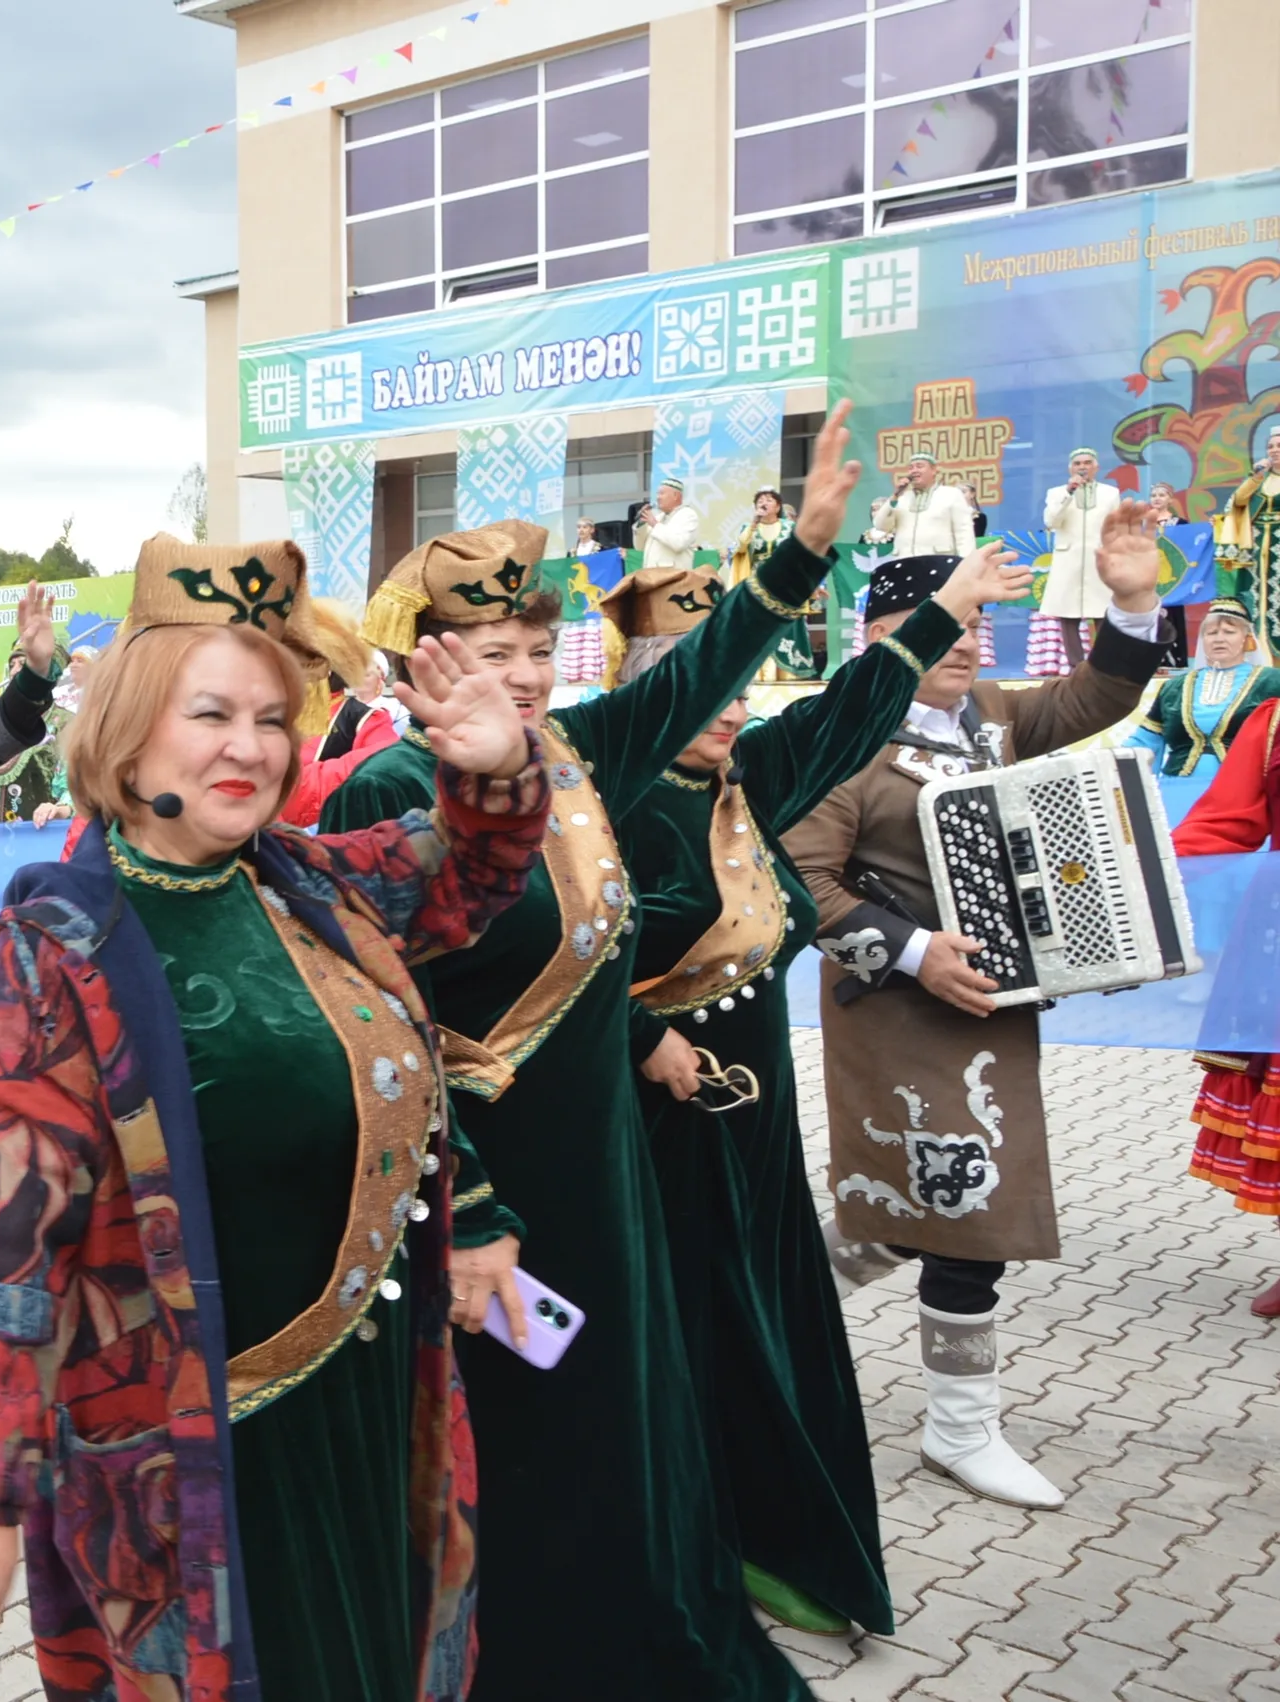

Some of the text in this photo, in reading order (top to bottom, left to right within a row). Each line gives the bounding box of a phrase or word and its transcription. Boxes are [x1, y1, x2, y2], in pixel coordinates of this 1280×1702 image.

[964, 216, 1280, 290] Межрегиональный фестиваль на
[372, 330, 642, 411] БАЙРАМ МЕНӘН!
[918, 385, 969, 420] АТА
[882, 424, 1008, 466] БАБАЛАР
